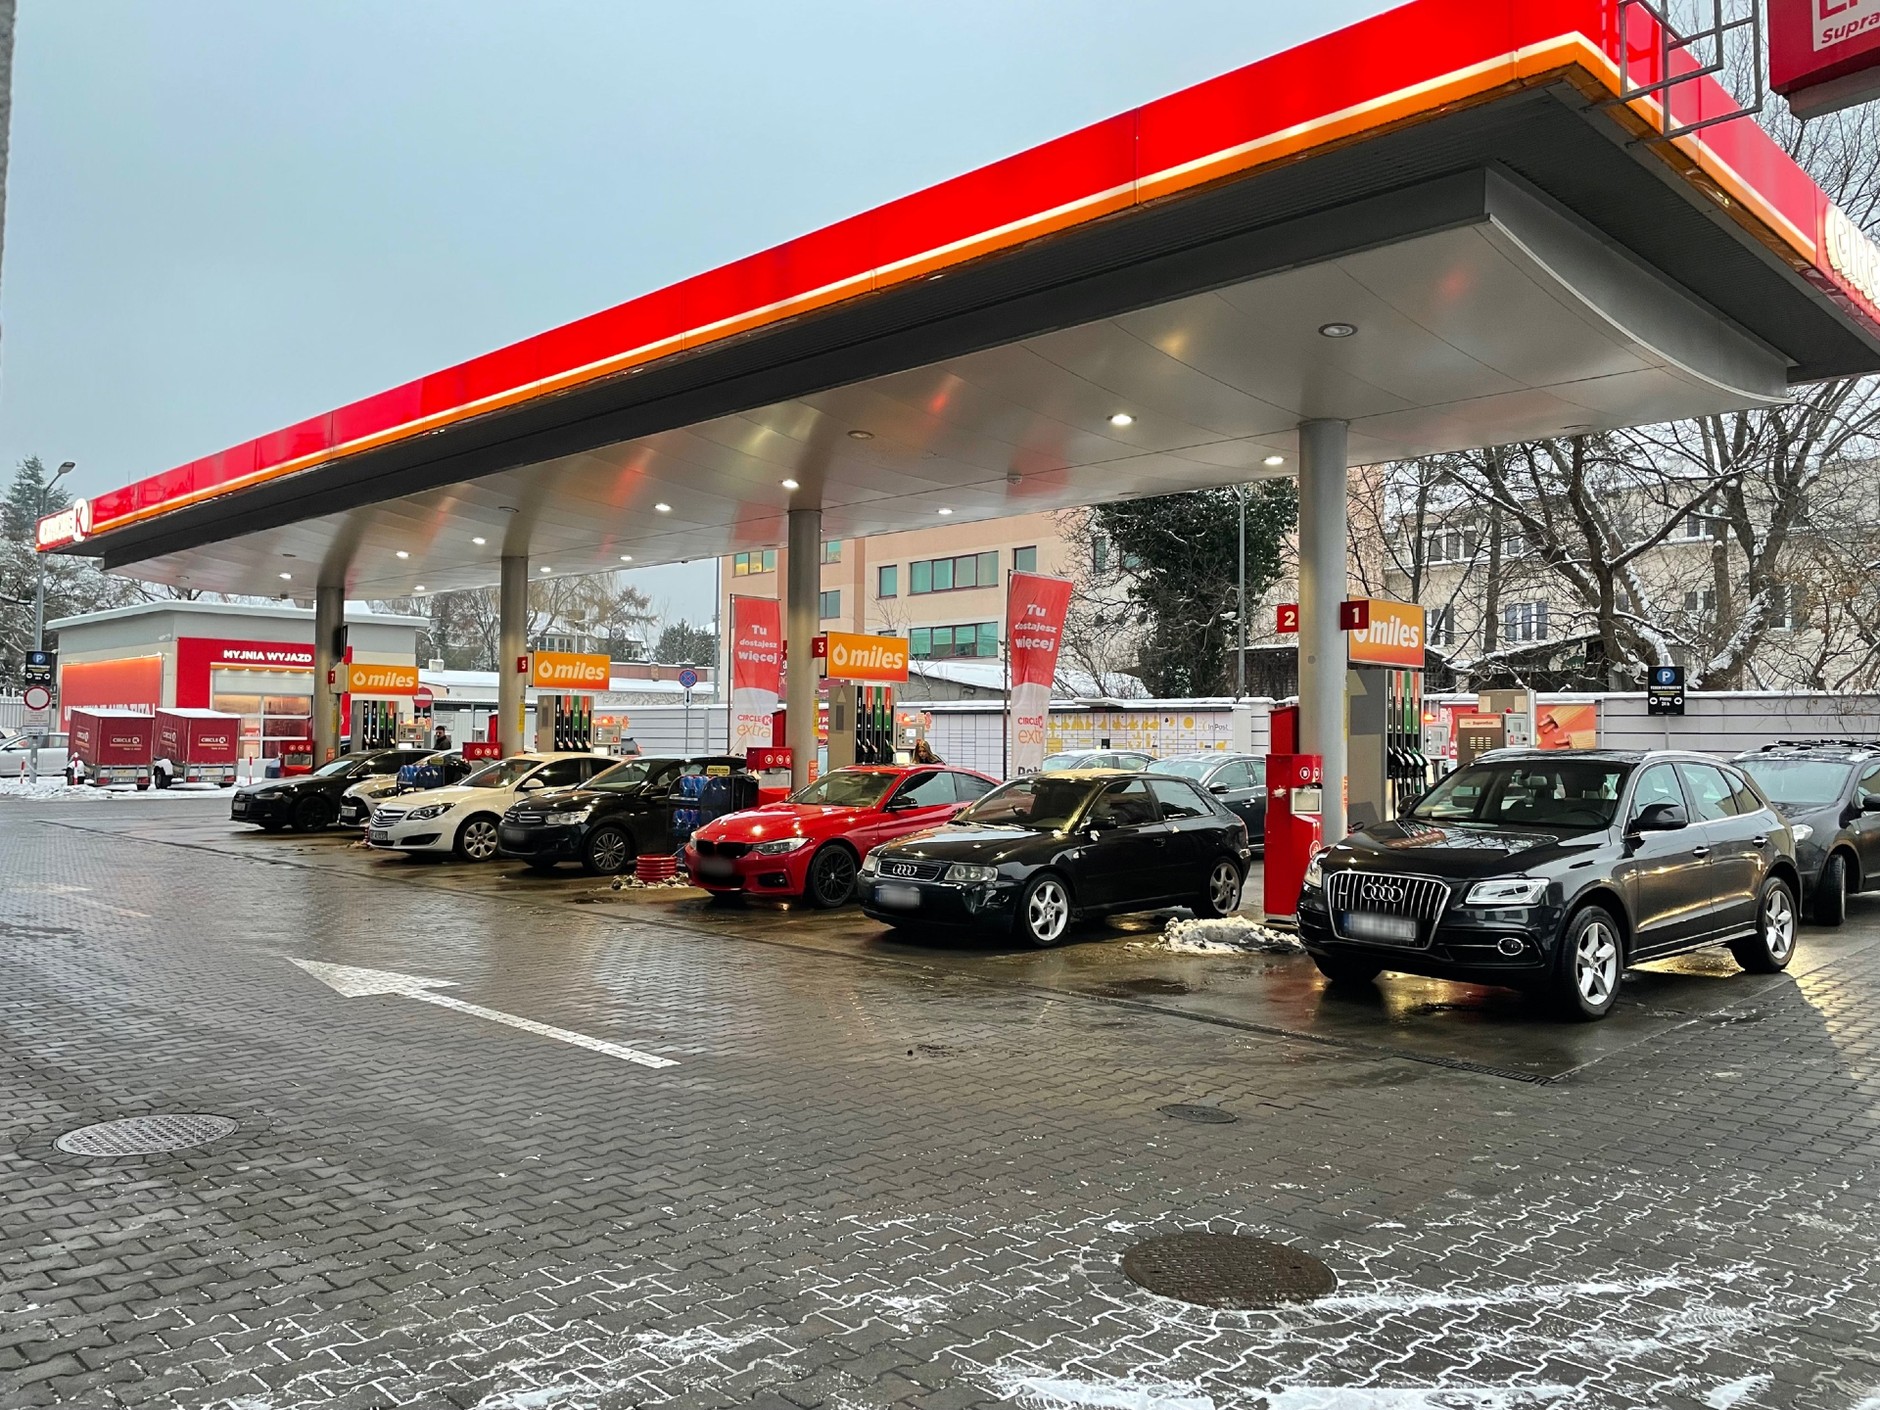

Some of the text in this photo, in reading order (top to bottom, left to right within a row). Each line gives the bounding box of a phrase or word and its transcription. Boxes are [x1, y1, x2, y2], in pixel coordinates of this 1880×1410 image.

[1027, 604, 1047, 617] Tu
[1352, 607, 1360, 624] 1
[1284, 611, 1296, 627] 2
[751, 625, 767, 636] Tu
[1369, 615, 1420, 648] miles
[739, 638, 778, 649] dostajesz
[818, 642, 824, 654] 3
[1015, 636, 1055, 652] więcej
[223, 649, 312, 663] MYJNIA WYJAZD
[738, 651, 778, 665] więcej
[849, 644, 904, 669] miles
[521, 660, 527, 670] 5
[554, 662, 606, 680] miles
[367, 671, 415, 687] miles
[737, 714, 773, 726] CIRCLE K
[737, 723, 771, 739] extra
